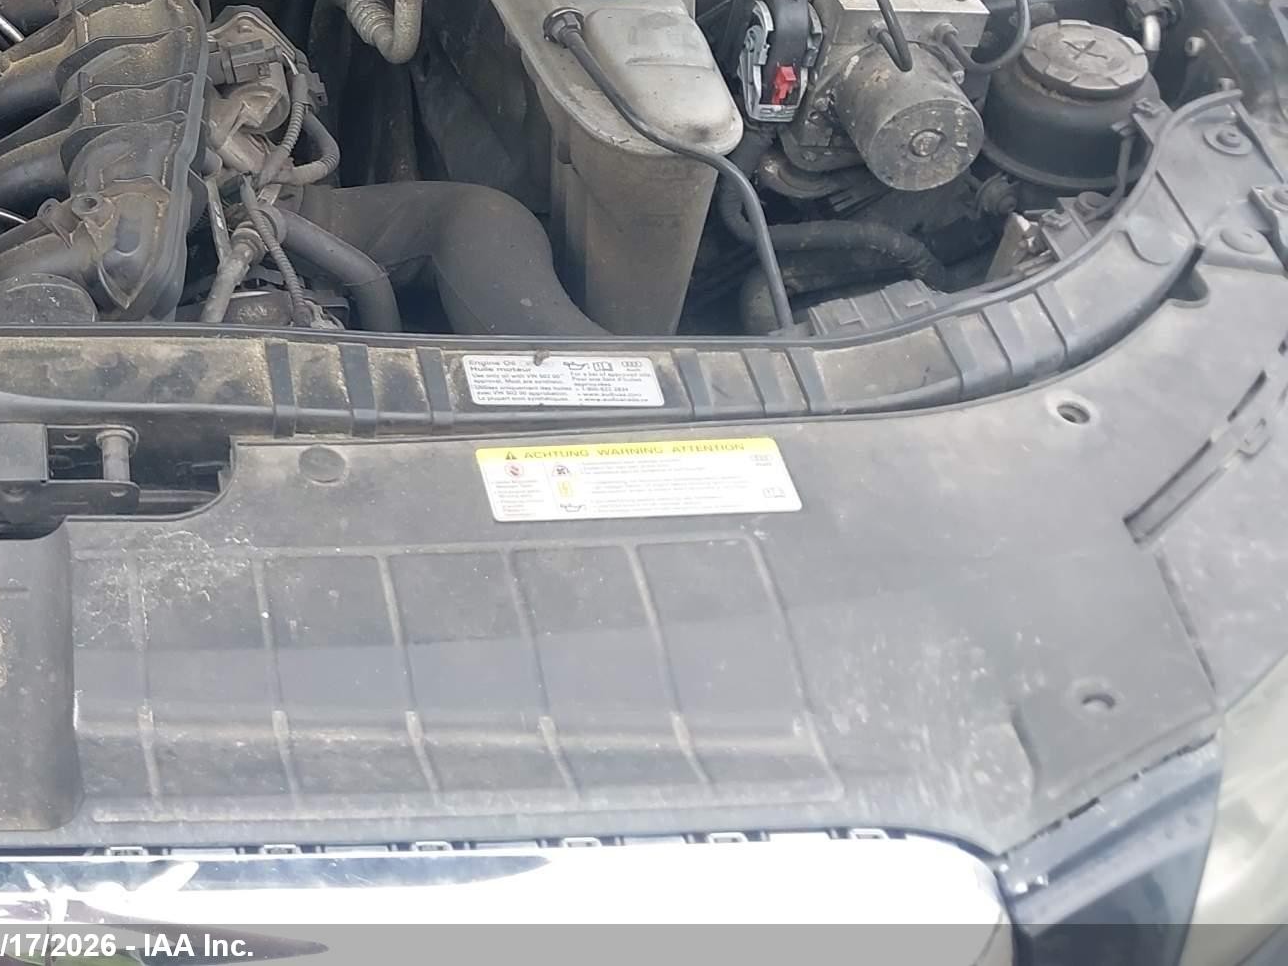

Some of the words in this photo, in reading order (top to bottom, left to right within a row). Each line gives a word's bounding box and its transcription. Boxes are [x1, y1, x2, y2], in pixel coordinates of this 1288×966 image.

[524, 450, 590, 458] ACHTUNG
[596, 447, 663, 455] WARNING
[671, 443, 745, 452] ATTENTION
